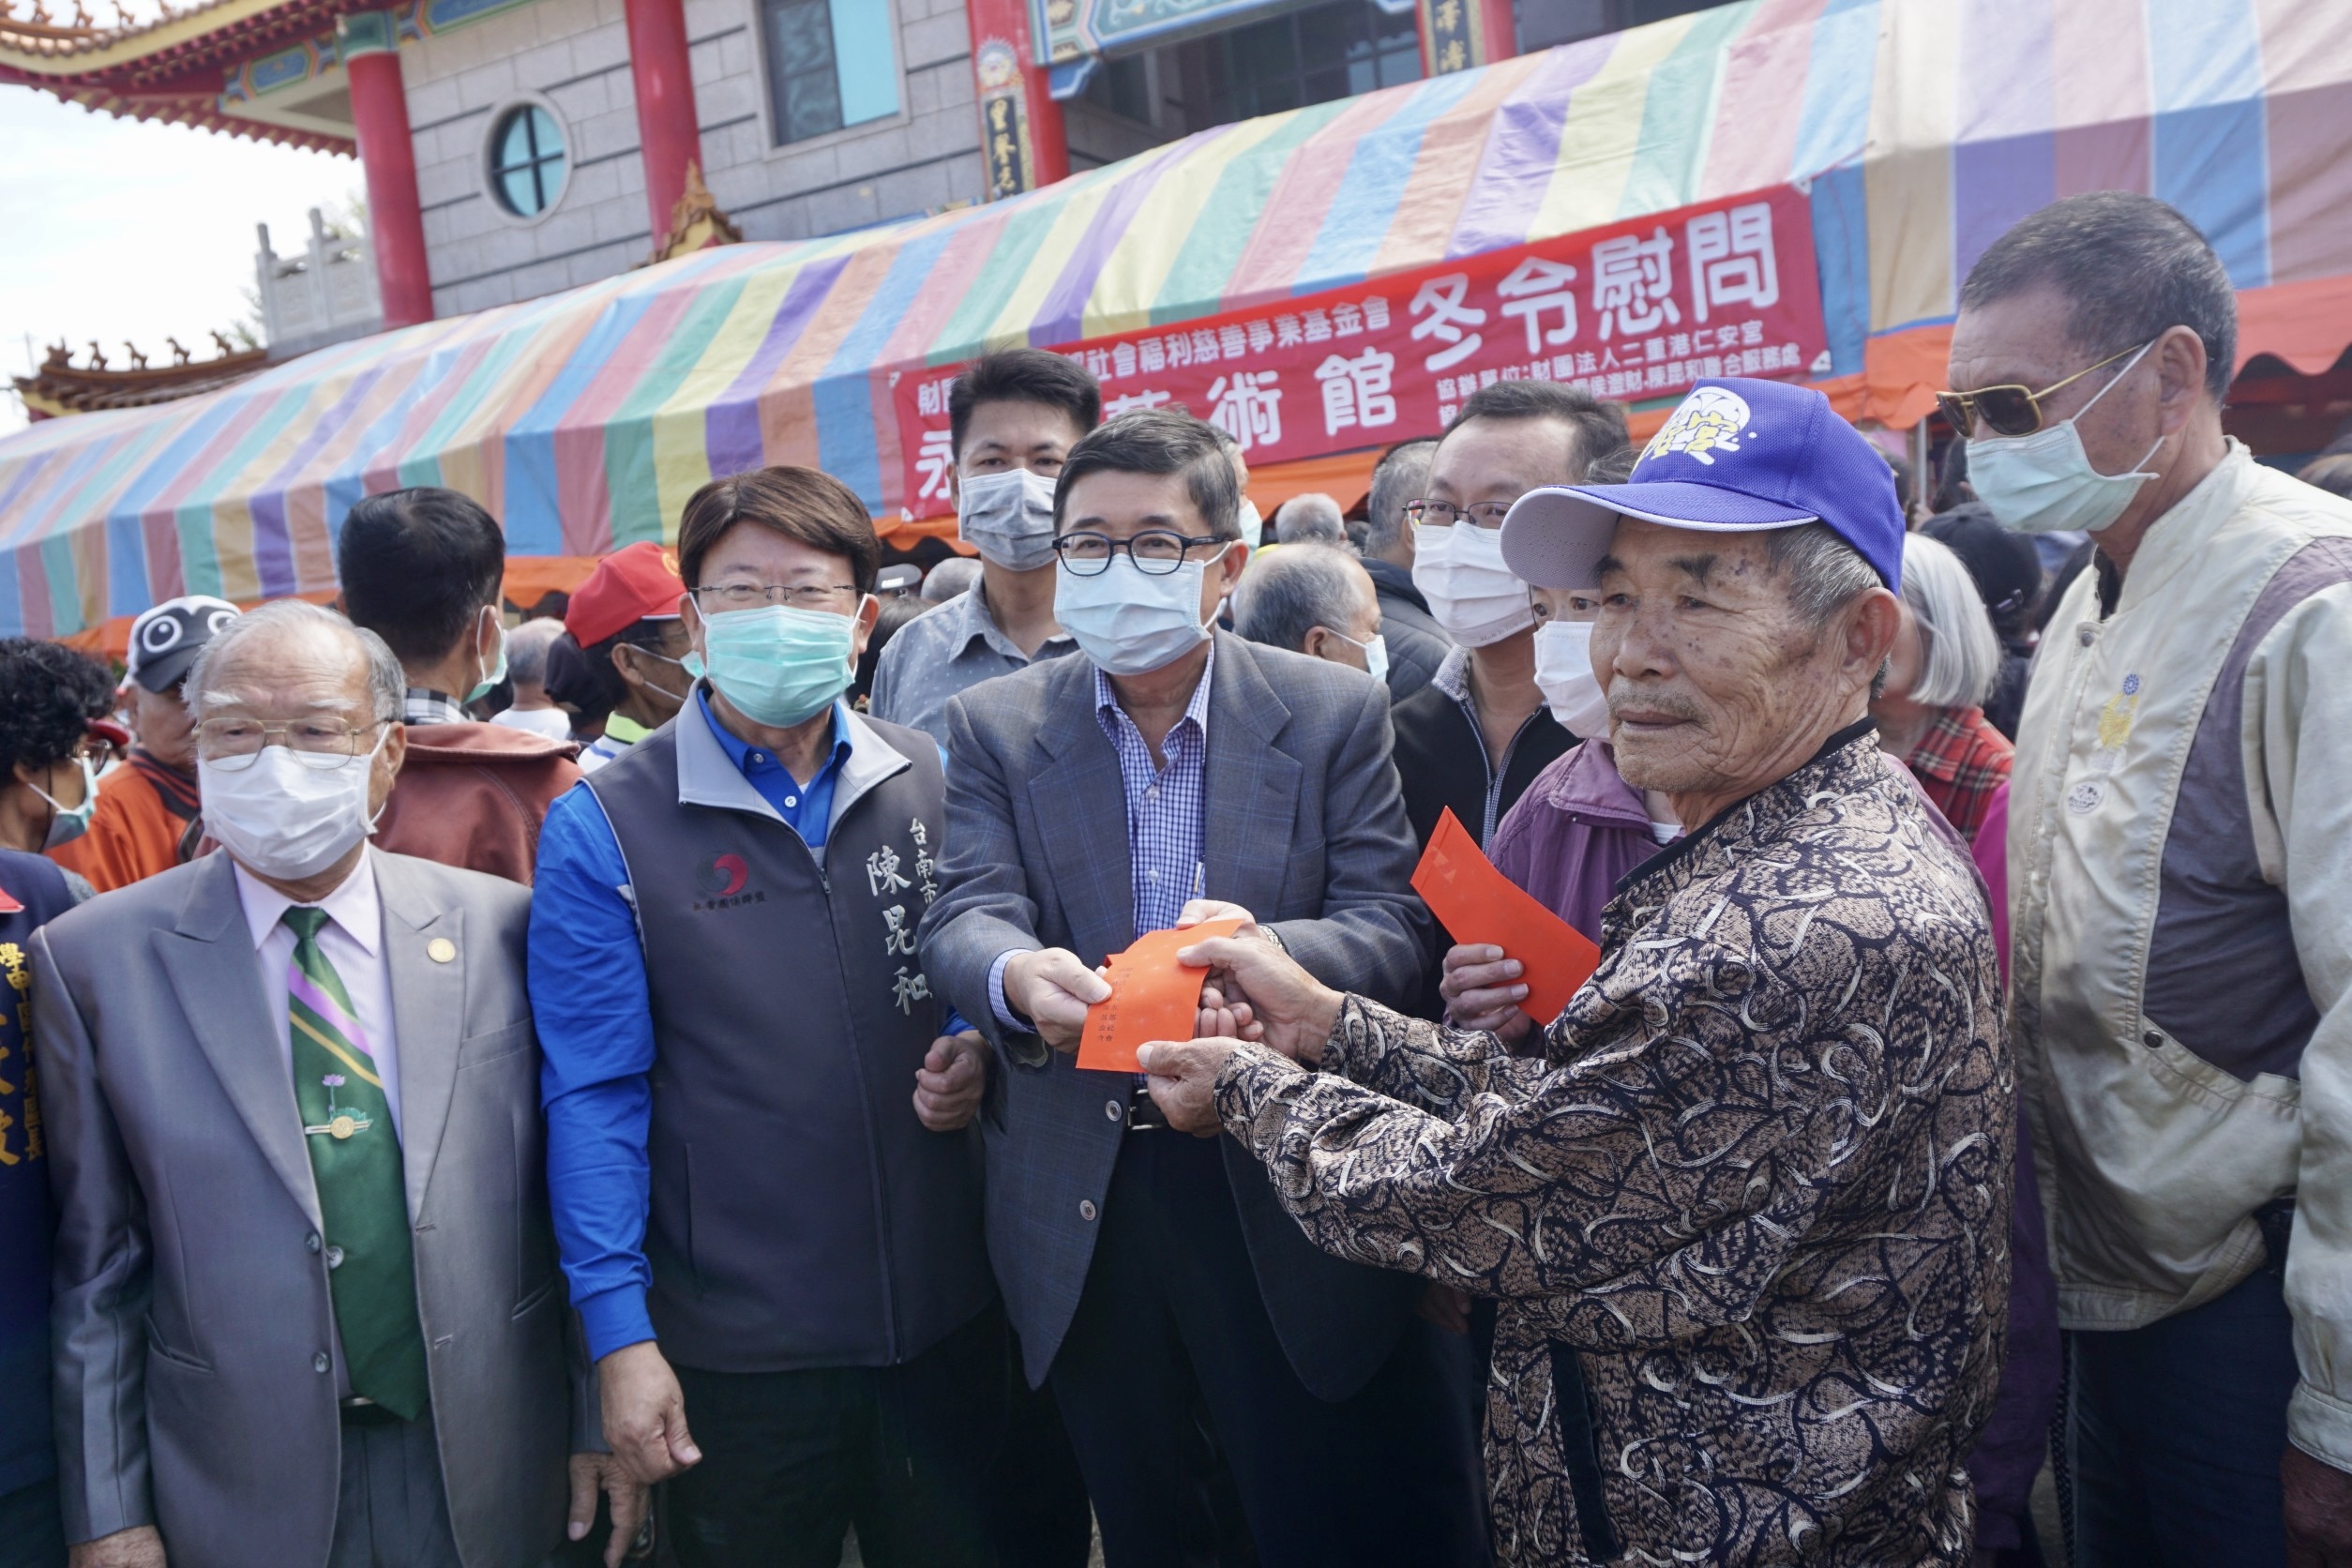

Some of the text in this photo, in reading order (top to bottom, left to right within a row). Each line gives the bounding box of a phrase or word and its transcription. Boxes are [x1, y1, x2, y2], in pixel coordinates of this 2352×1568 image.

[1410, 201, 1780, 371] 冬令慰問
[867, 845, 933, 1017] 陳昆和
